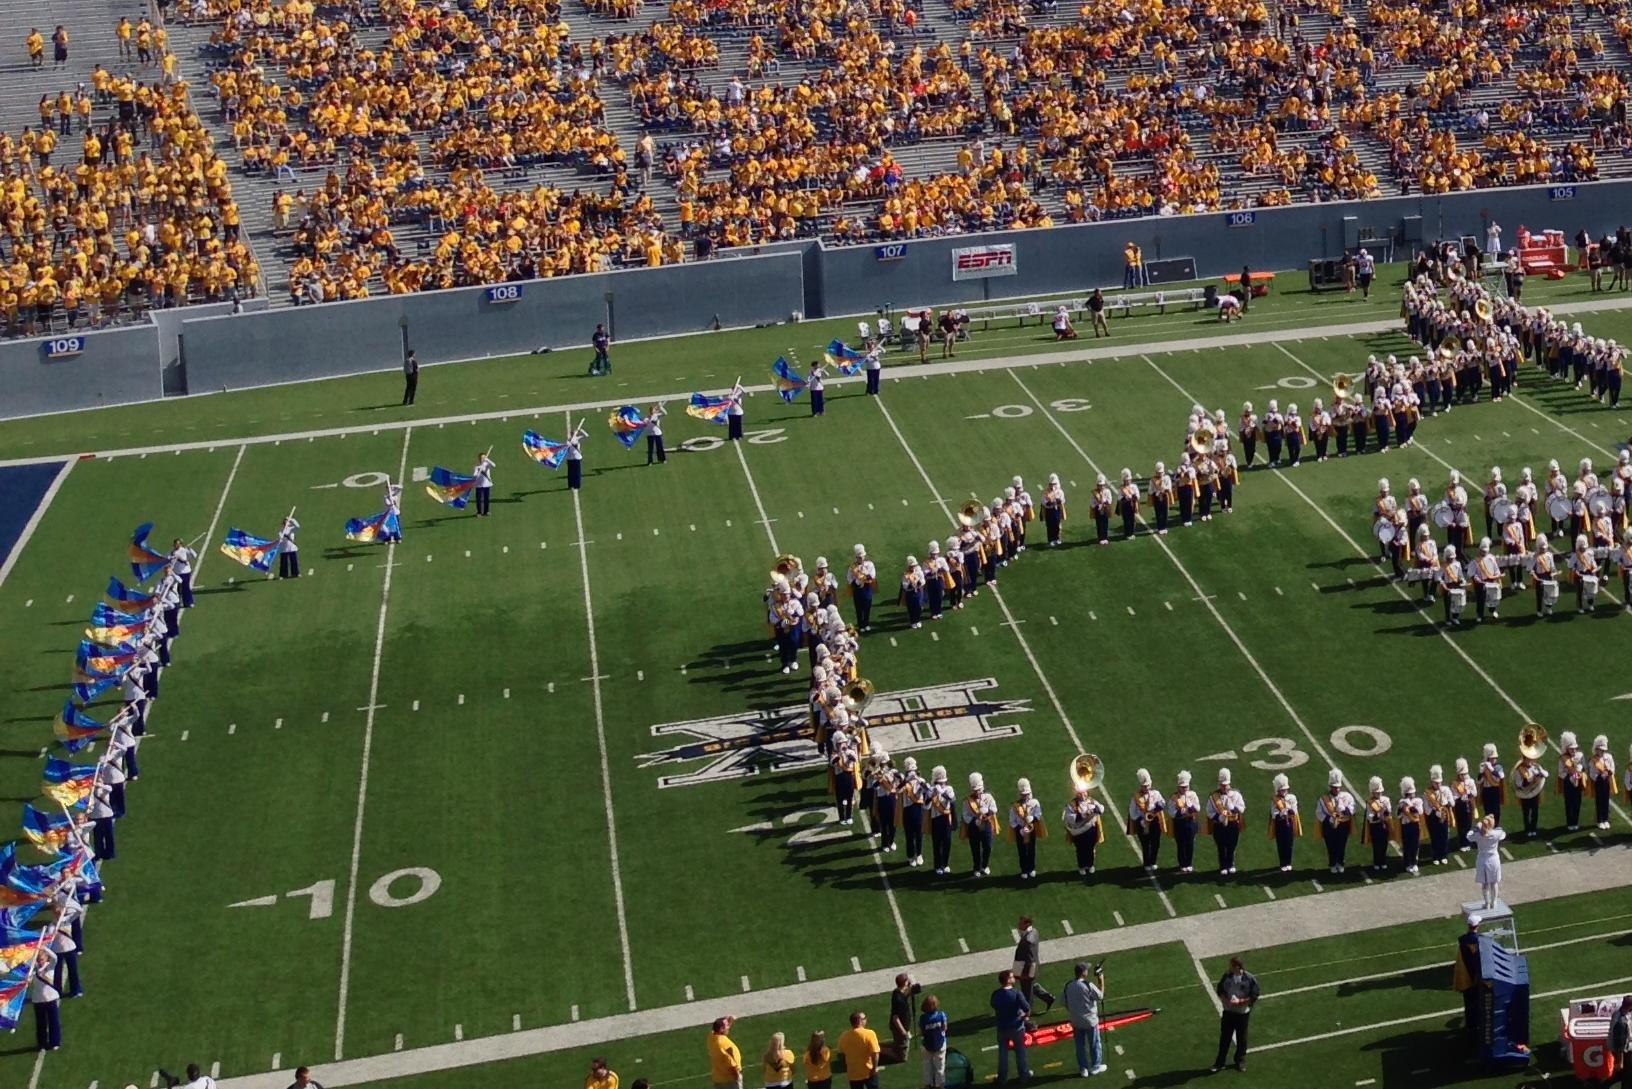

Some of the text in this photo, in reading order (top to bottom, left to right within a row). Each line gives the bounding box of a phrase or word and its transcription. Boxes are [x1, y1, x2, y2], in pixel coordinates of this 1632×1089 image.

[1552, 187, 1574, 199] 105
[1231, 211, 1253, 225] 106
[881, 244, 904, 259] 107
[958, 250, 1012, 269] ESPN
[490, 285, 519, 300] 108
[49, 338, 80, 353] 109
[1242, 724, 1394, 771] 30
[286, 866, 442, 919] 10
[1583, 1046, 1604, 1067] G
